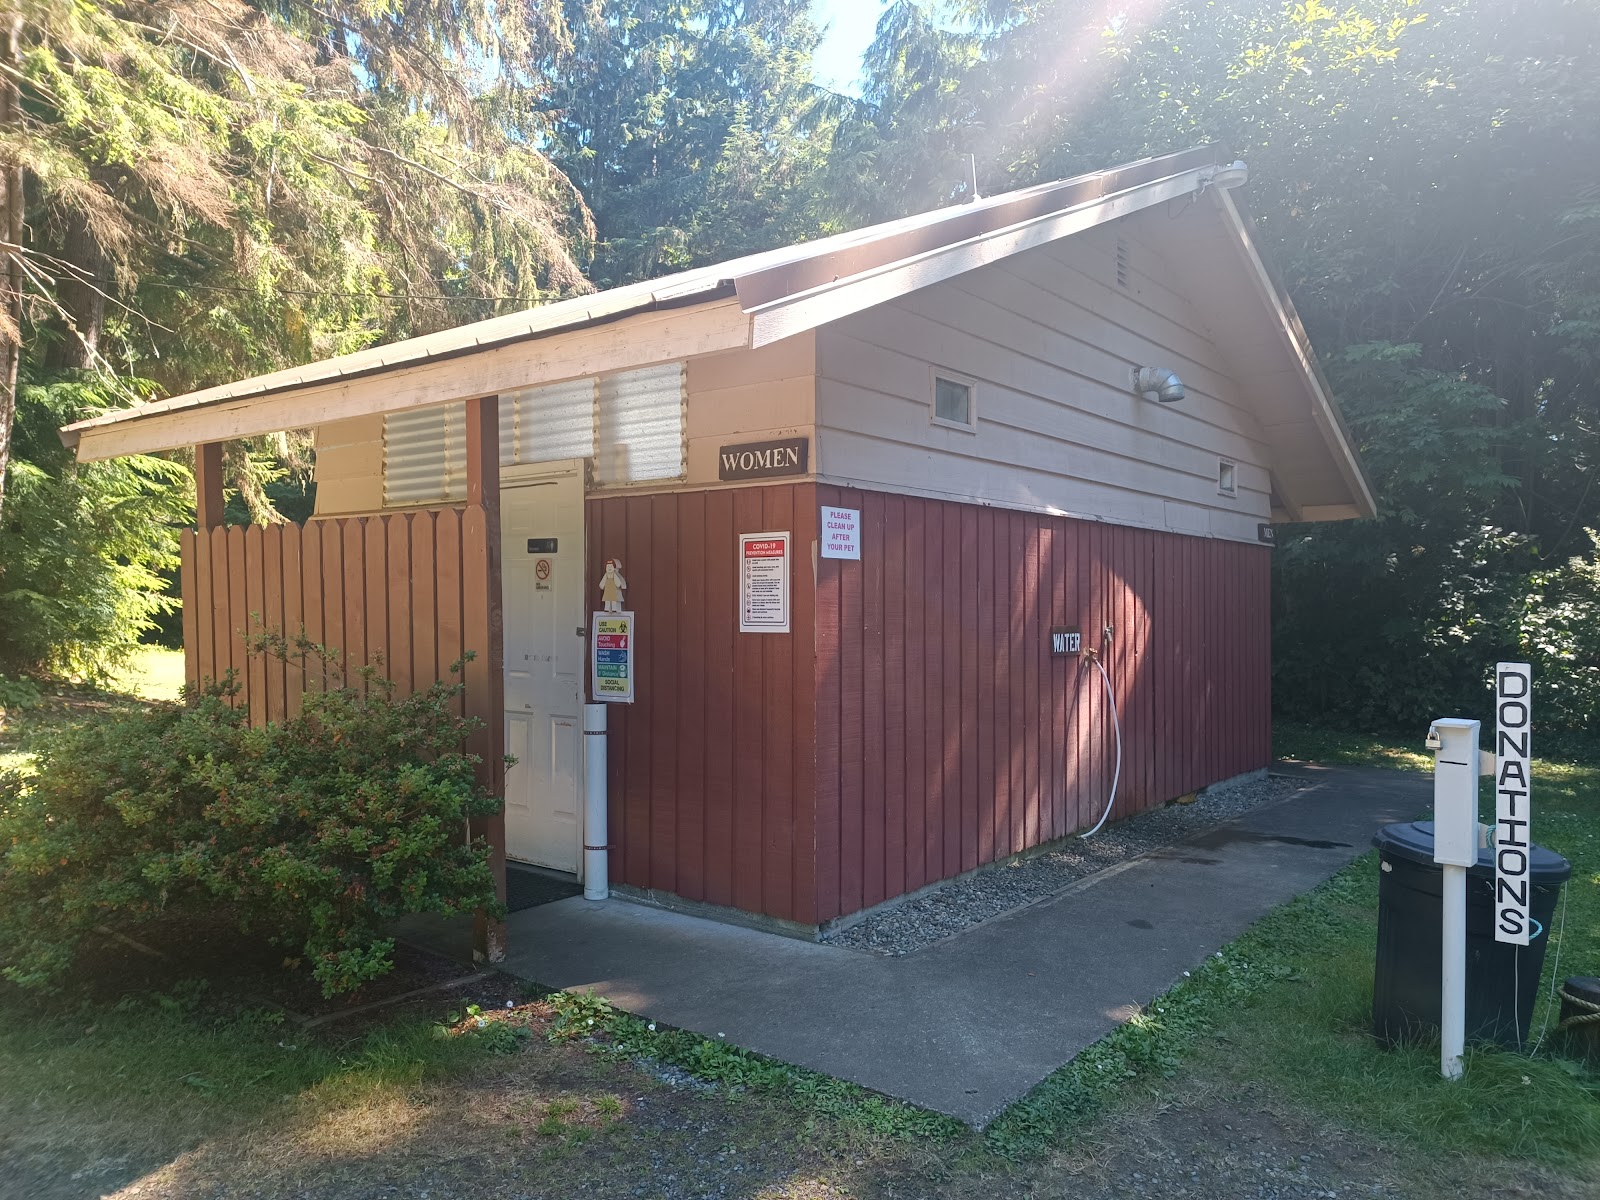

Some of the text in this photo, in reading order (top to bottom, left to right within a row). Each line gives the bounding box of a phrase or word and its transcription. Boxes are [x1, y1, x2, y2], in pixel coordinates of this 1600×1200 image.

[722, 447, 798, 472] WOMEN
[830, 512, 851, 520] PLEASE
[827, 522, 845, 530] CLEAN
[832, 533, 850, 541] AFTER
[827, 543, 843, 551] YOUR
[1053, 633, 1080, 652] WATER
[1498, 671, 1528, 935] DONATIONS
